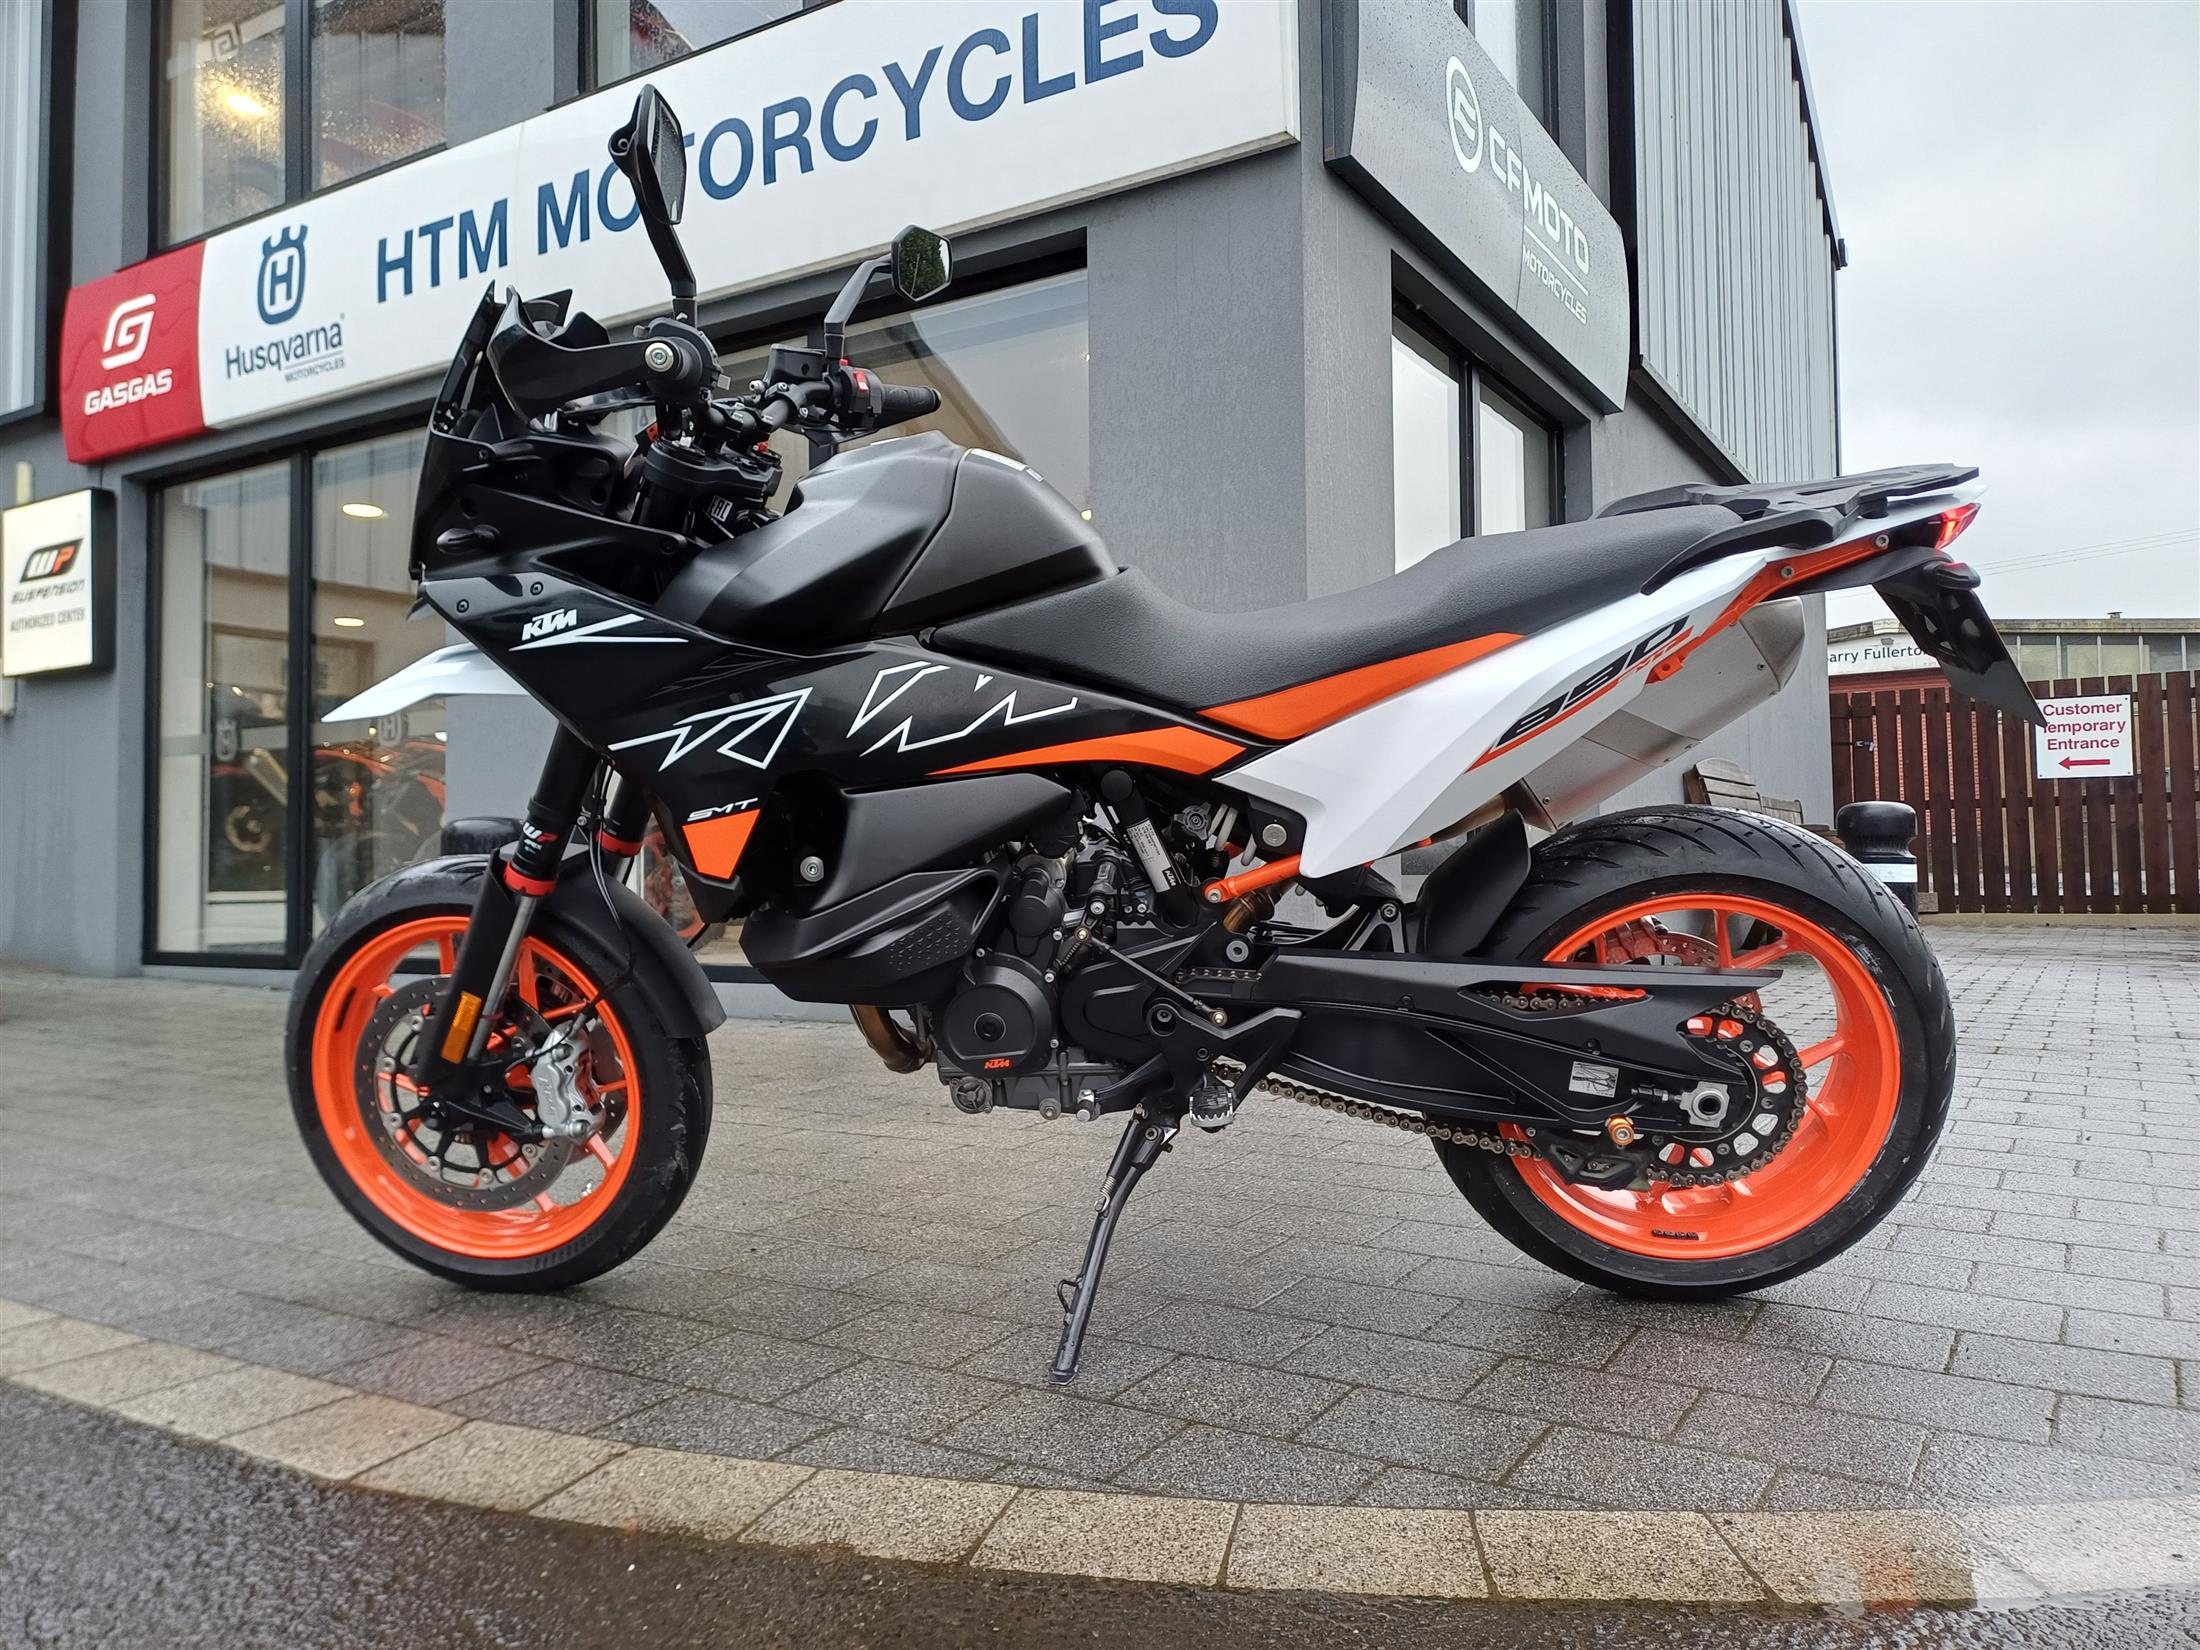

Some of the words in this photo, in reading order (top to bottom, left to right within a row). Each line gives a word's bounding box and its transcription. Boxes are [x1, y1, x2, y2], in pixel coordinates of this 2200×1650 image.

[377, 197, 509, 303] HTM
[537, 0, 1220, 255] MOORCYCLES
[1489, 125, 1590, 275] CFMOTO
[1522, 245, 1588, 325] MOTORCYCLES
[226, 321, 343, 379] Husqvarna
[83, 368, 173, 416] GASGAS
[521, 608, 577, 641] KTM
[1826, 652, 1860, 664] arry
[1864, 646, 1927, 660] Fullerto
[2042, 703, 2123, 717] Customer
[2047, 738, 2121, 751] Entrance
[687, 797, 759, 822] SMT
[984, 1058, 1010, 1069] KTM
